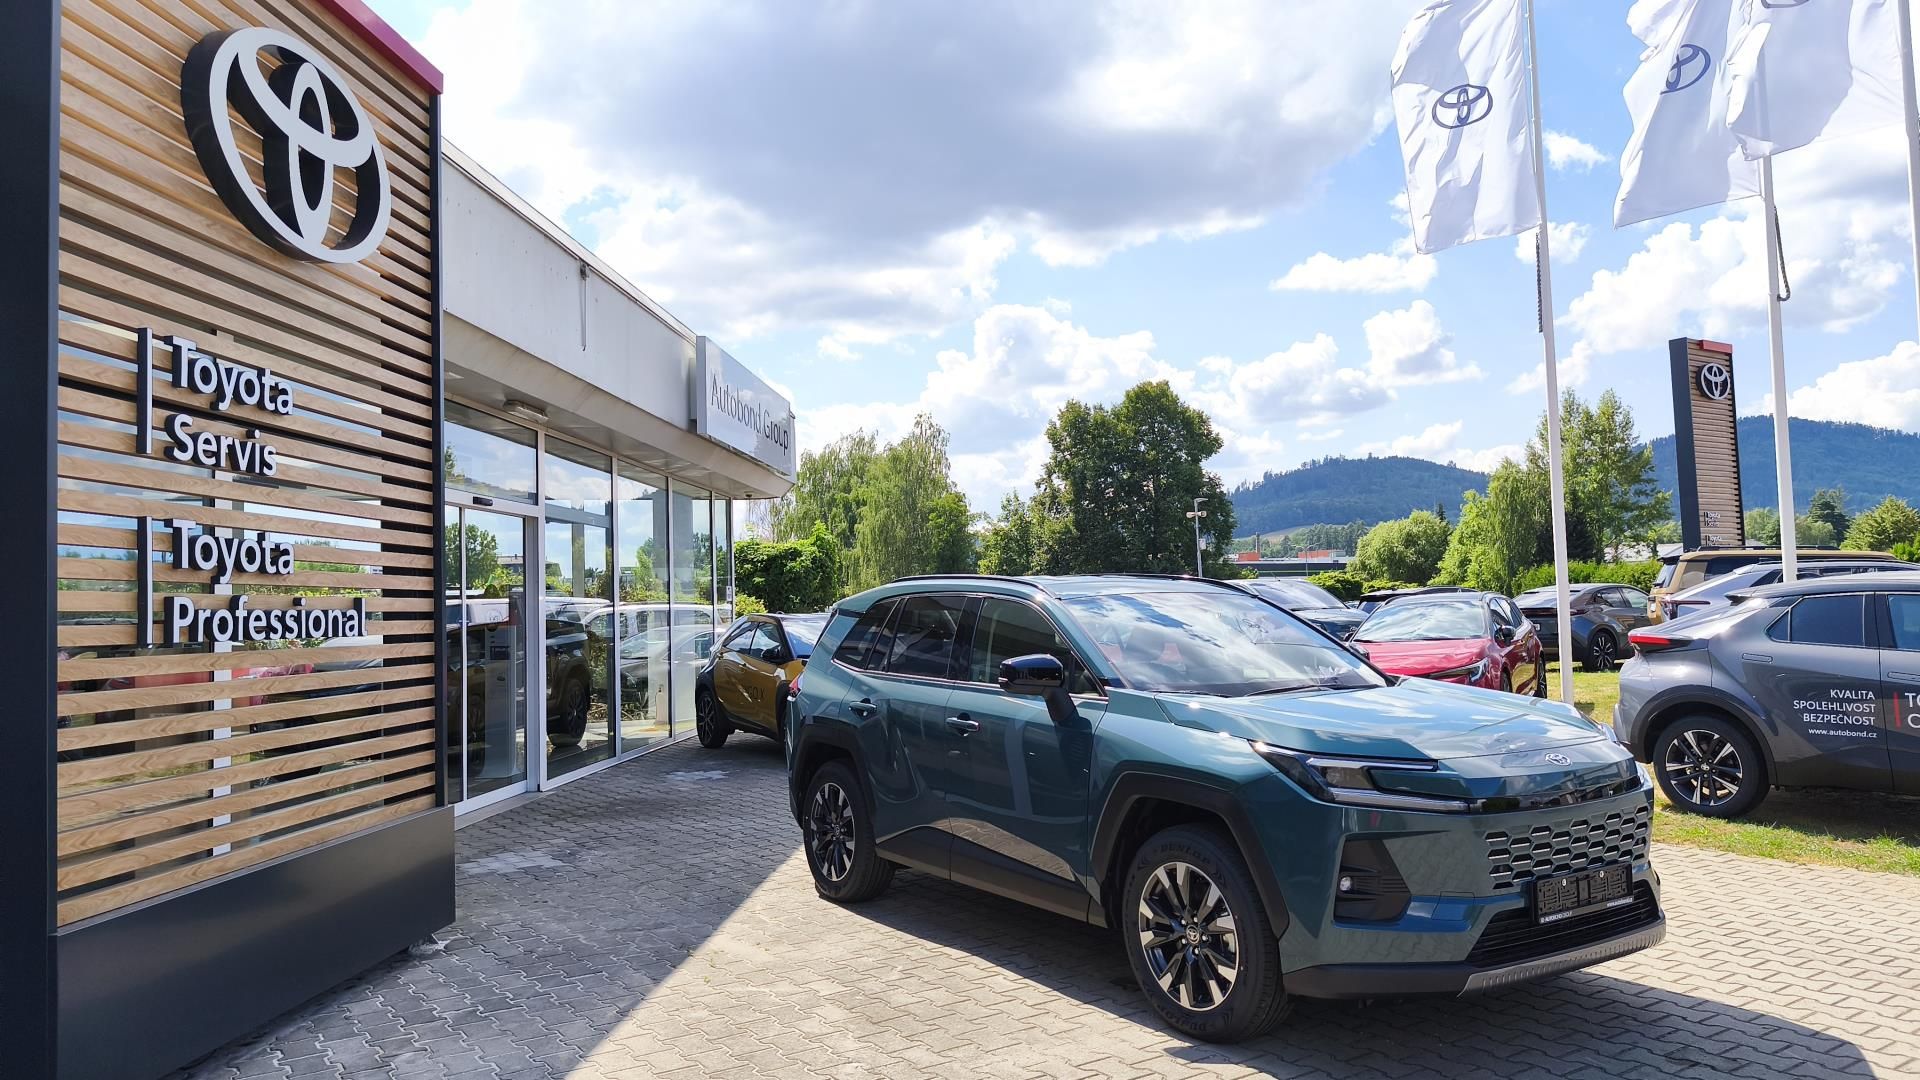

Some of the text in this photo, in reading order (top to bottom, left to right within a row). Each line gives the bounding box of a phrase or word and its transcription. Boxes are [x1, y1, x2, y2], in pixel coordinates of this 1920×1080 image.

[164, 335, 294, 416] Toyota
[711, 373, 789, 456] Autobond Group
[164, 413, 278, 477] Servis
[164, 518, 295, 584] Toyota
[164, 595, 368, 644] Professional
[1793, 700, 1876, 713] SPOLEHLIVOST
[1830, 689, 1875, 700] KVALITA
[1904, 692, 1920, 708] T
[1803, 713, 1875, 726] BEZPEČNOST
[1808, 728, 1877, 738] www.autobond.cz
